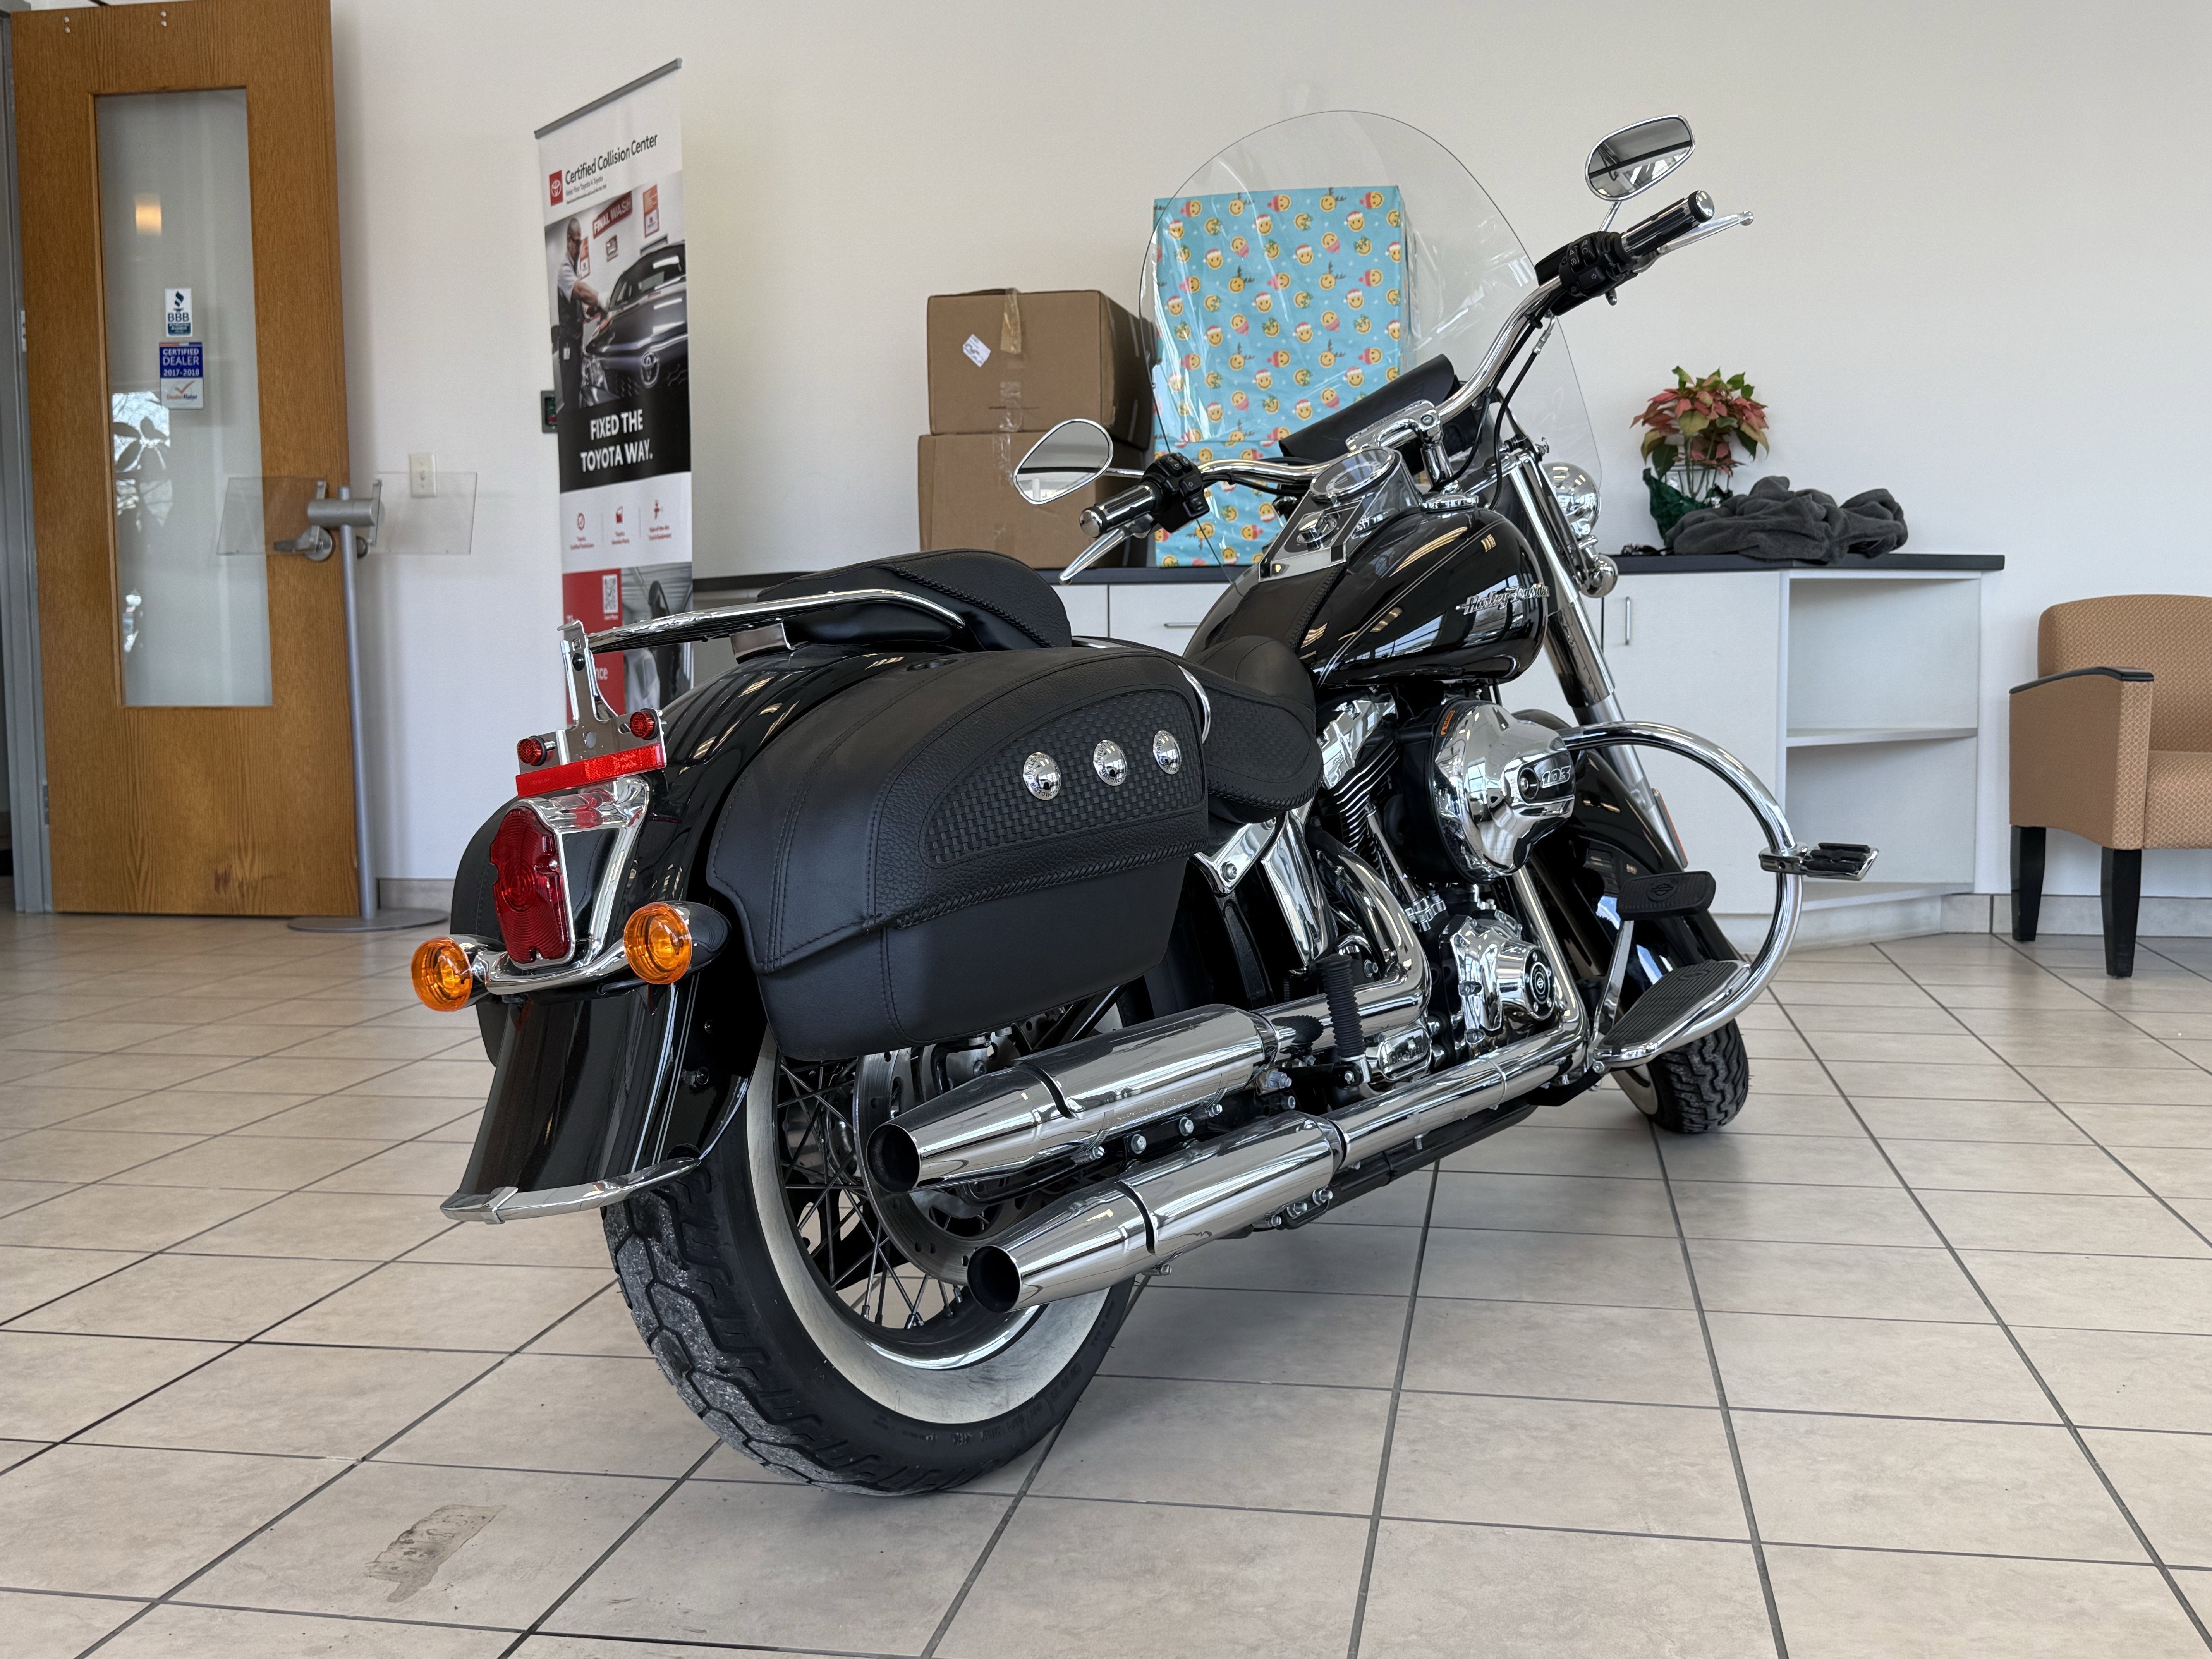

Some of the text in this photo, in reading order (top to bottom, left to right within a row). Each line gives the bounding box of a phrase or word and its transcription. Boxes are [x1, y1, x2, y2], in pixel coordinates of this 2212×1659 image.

[566, 134, 658, 185] Certified Collision Center
[594, 198, 631, 235] FINAL WASH
[168, 312, 189, 322] BBB
[163, 348, 199, 356] CERTIFIED
[163, 356, 199, 366] DEALER
[163, 368, 200, 376] 2017-2018
[590, 409, 643, 441] FIXED THE
[580, 438, 653, 472] TOYOTA WAY.
[1541, 765, 1571, 788] 103
